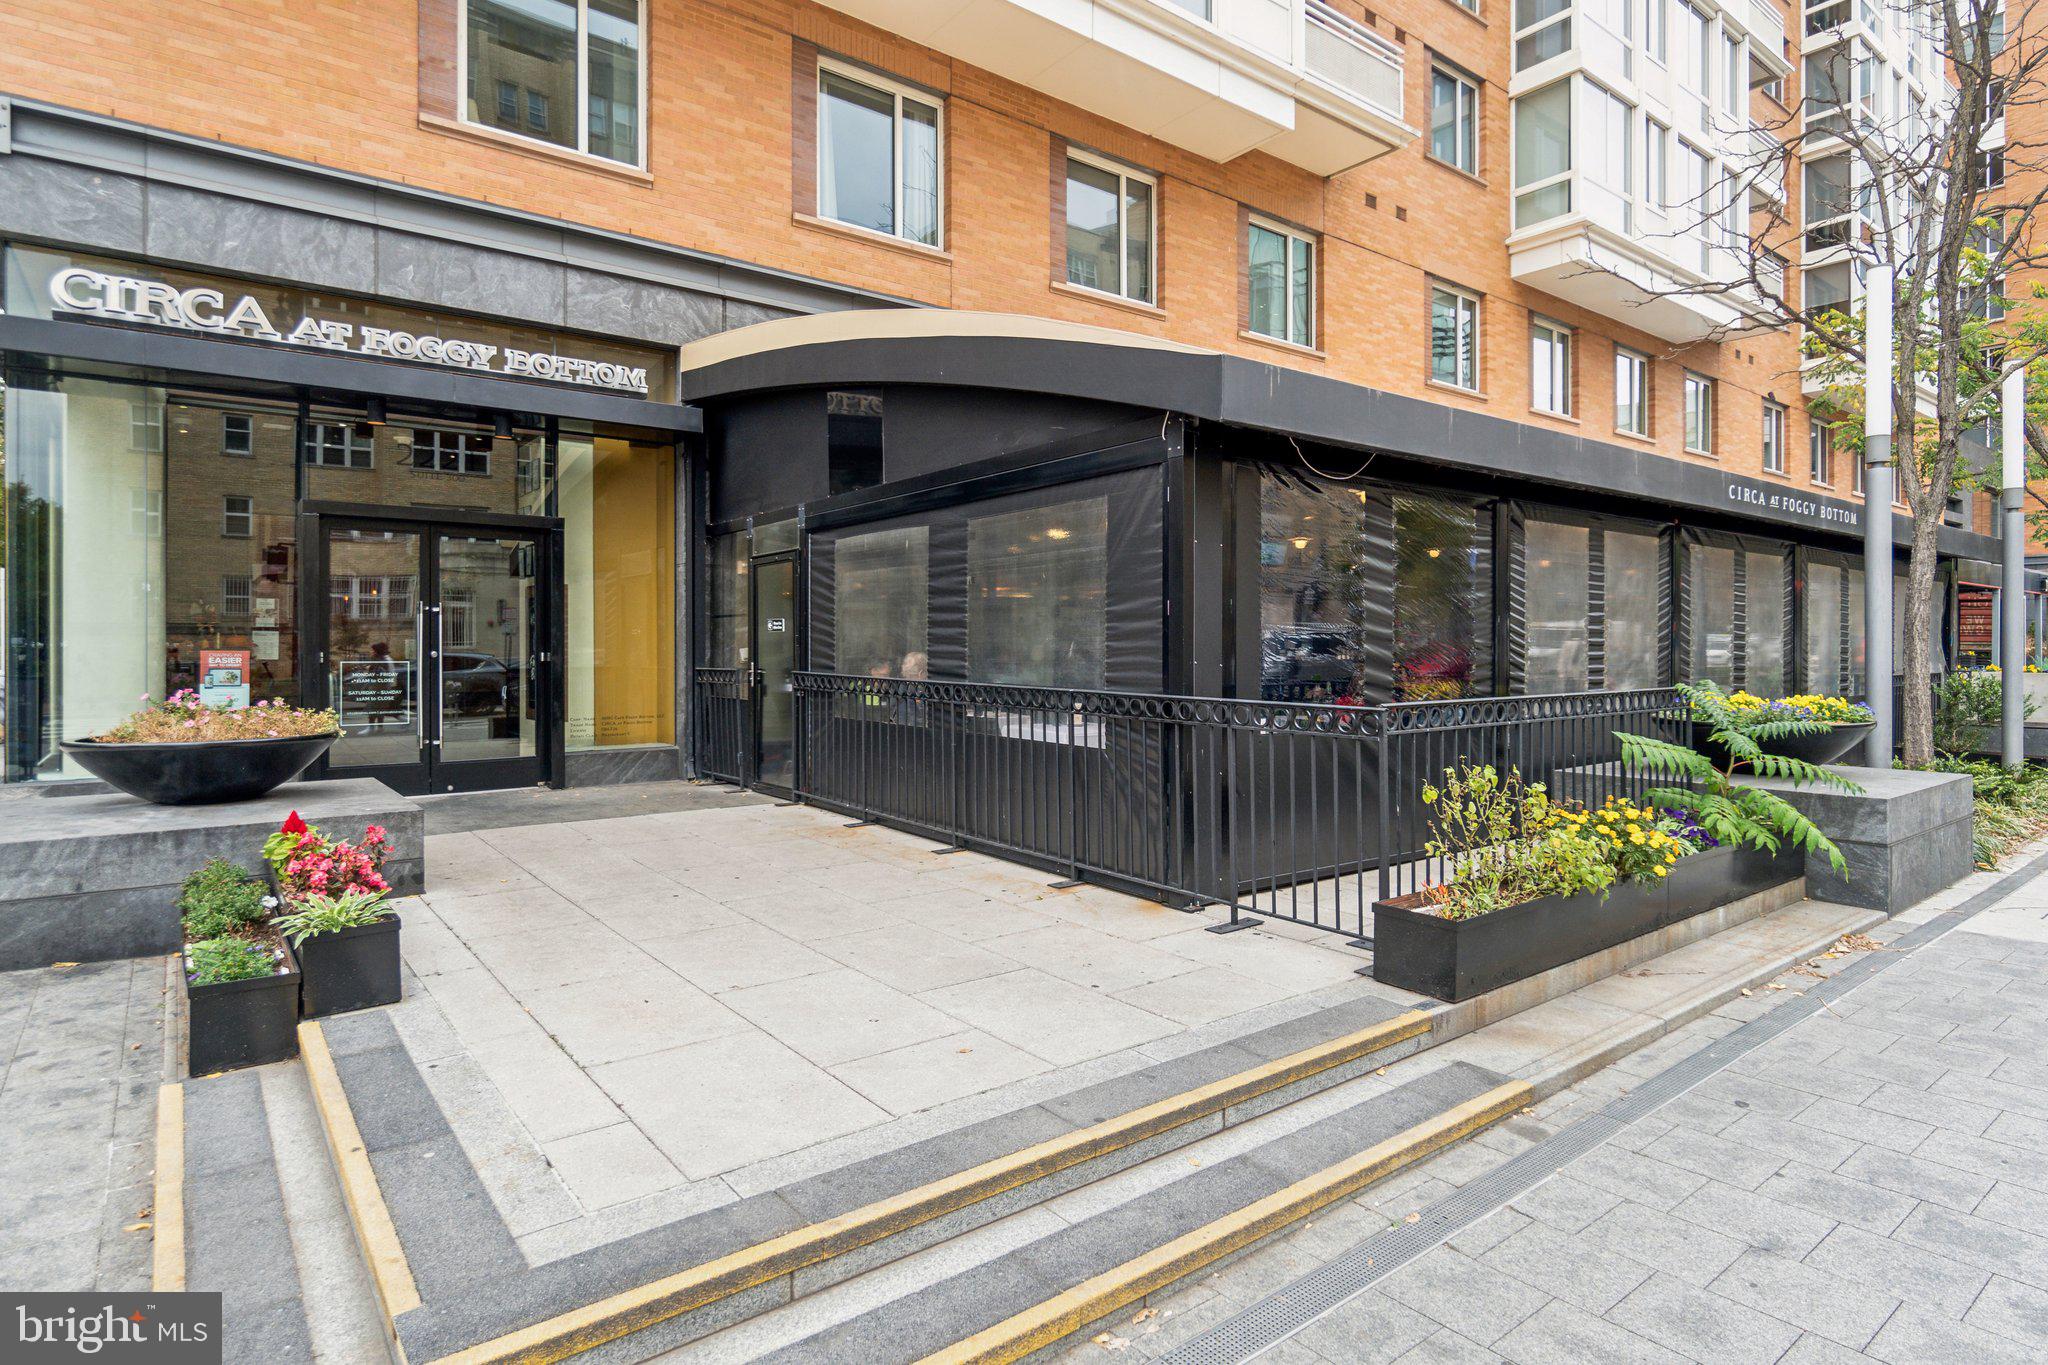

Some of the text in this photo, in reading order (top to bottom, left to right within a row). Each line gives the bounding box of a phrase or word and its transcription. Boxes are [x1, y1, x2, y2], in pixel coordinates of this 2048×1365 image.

[51, 268, 648, 393] CIRCA AT FOGGY BOTTOM
[1728, 484, 1857, 525] CIRCA AT FOGGY BOTTOM
